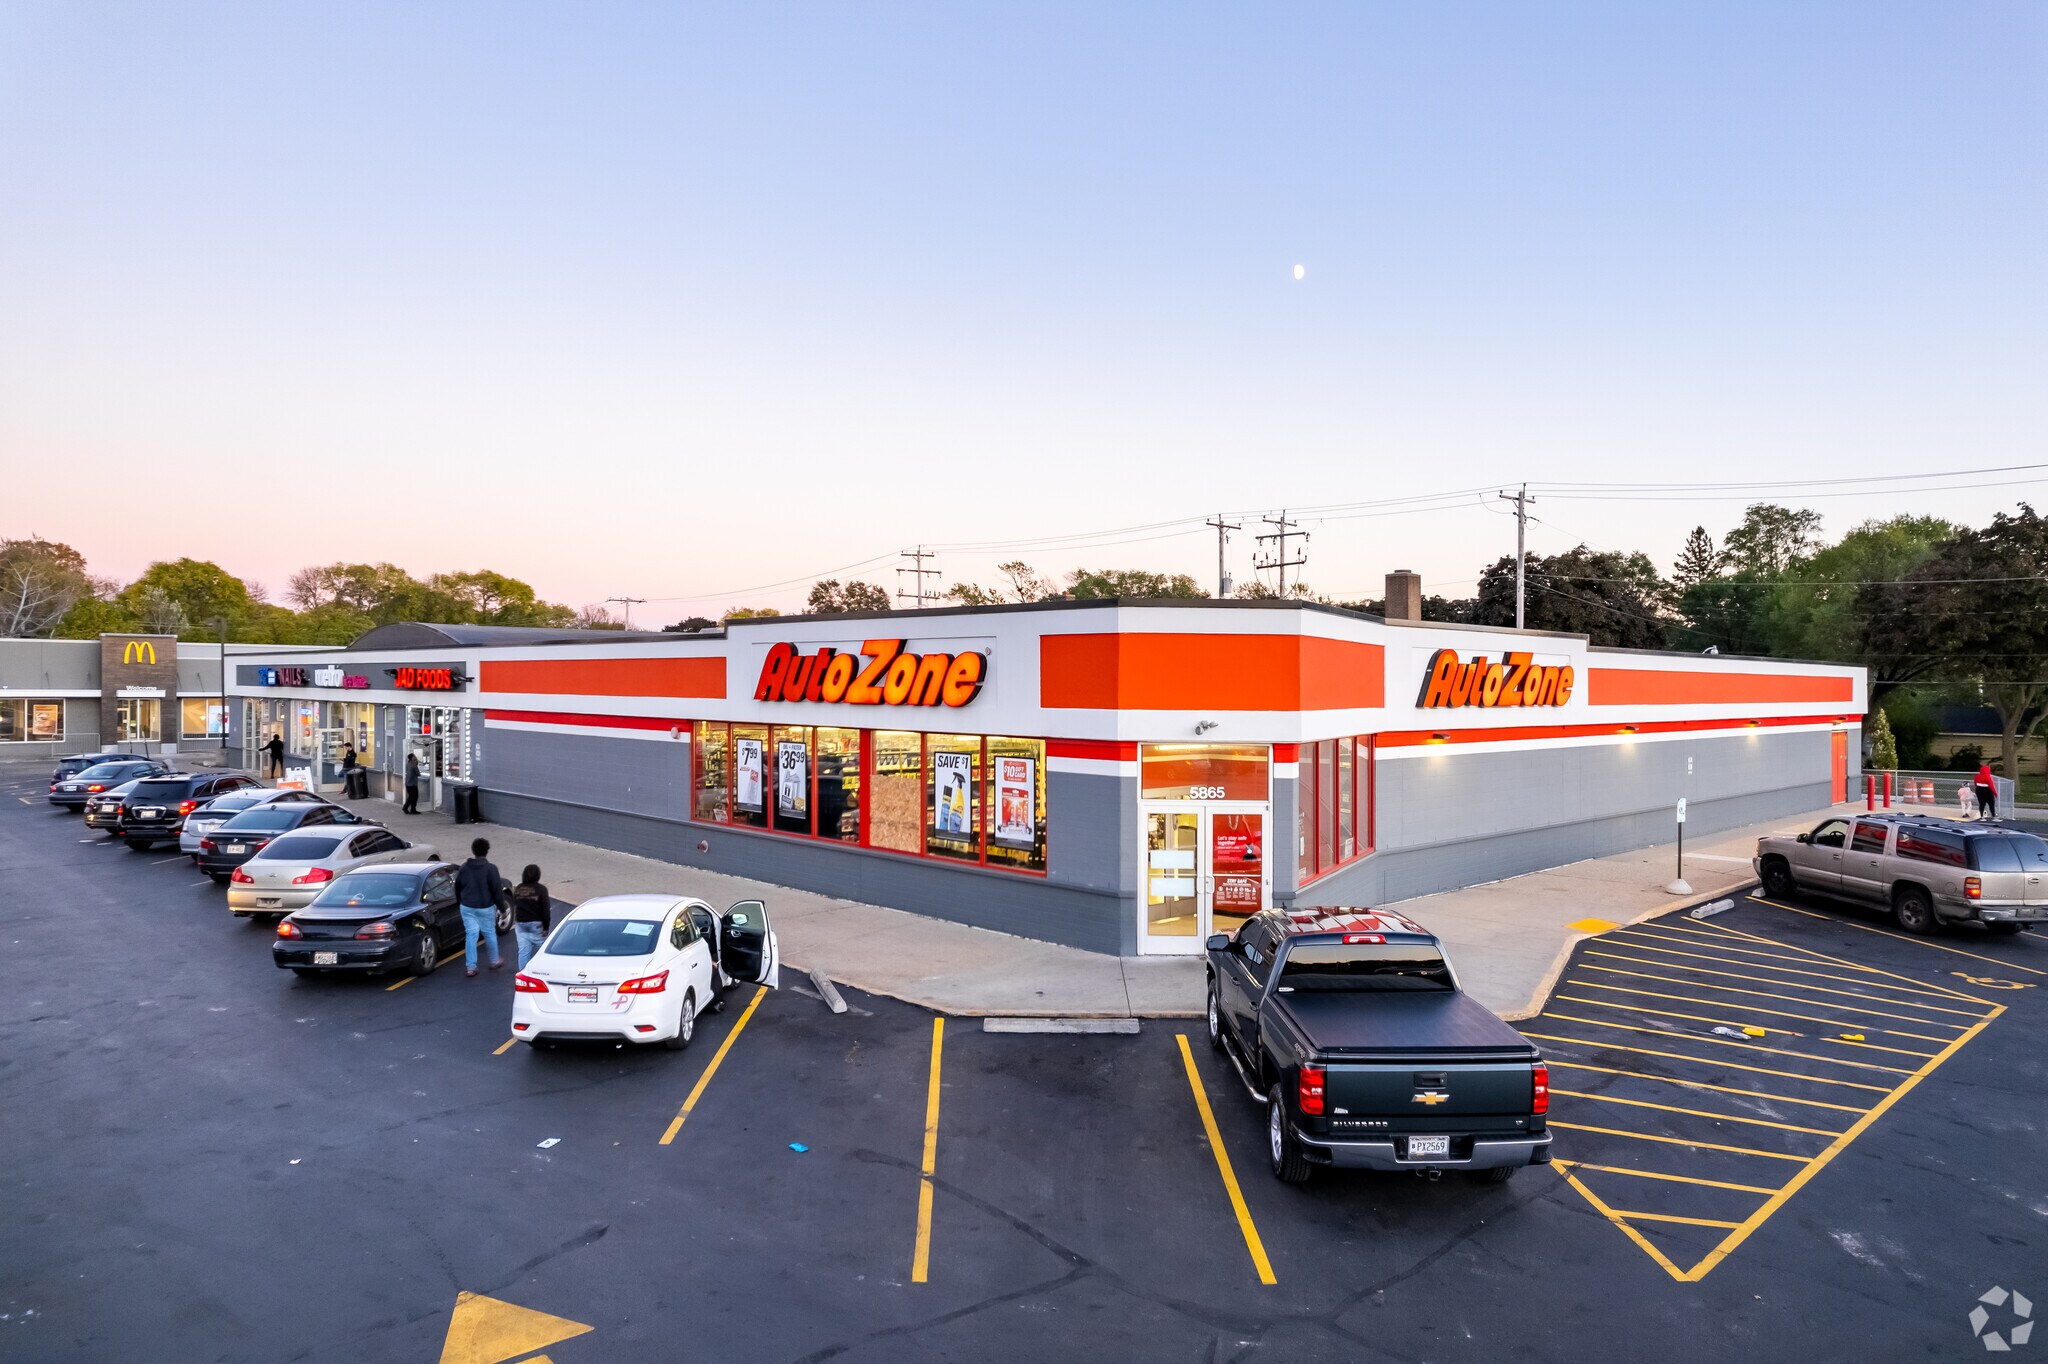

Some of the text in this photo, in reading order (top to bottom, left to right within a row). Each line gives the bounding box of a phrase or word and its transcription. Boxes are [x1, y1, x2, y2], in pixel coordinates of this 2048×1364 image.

[278, 667, 302, 687] NAILS
[394, 667, 415, 689] JAD
[416, 668, 452, 690] FOODS
[753, 638, 988, 708] AutoZone
[1415, 648, 1575, 708] AutoZone
[937, 755, 969, 770] SAVE $1
[1004, 765, 1015, 778] $10
[1189, 786, 1225, 799] 5865
[1417, 1141, 1446, 1151] PX2569
